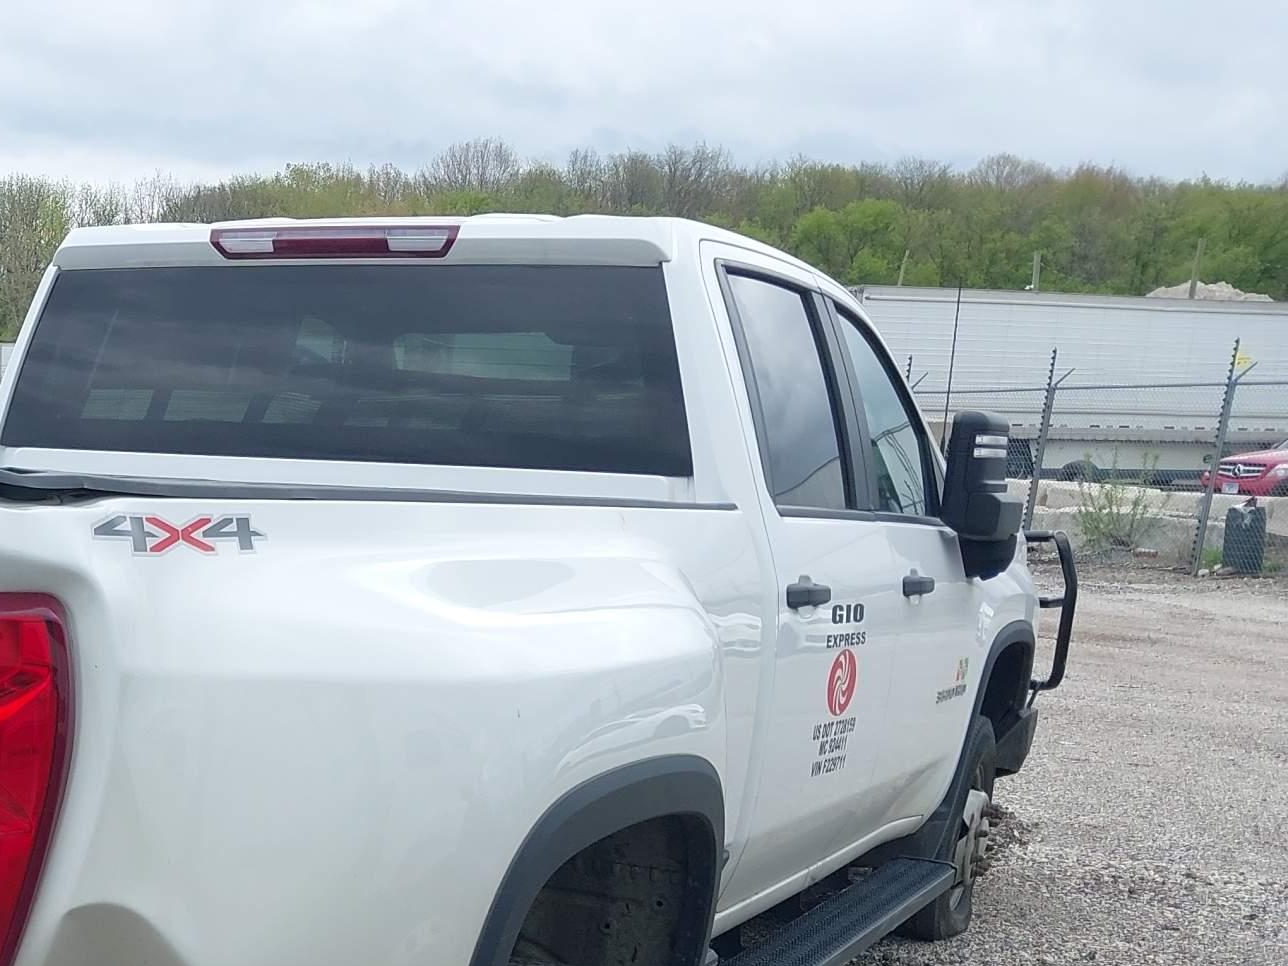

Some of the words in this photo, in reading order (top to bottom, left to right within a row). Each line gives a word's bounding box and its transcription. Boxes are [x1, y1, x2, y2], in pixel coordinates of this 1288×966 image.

[831, 603, 865, 624] GIO
[826, 631, 866, 649] EXPRESS
[812, 724, 822, 741] US
[821, 721, 835, 739] DOT
[818, 739, 829, 756] MC
[810, 760, 823, 777] VIN
